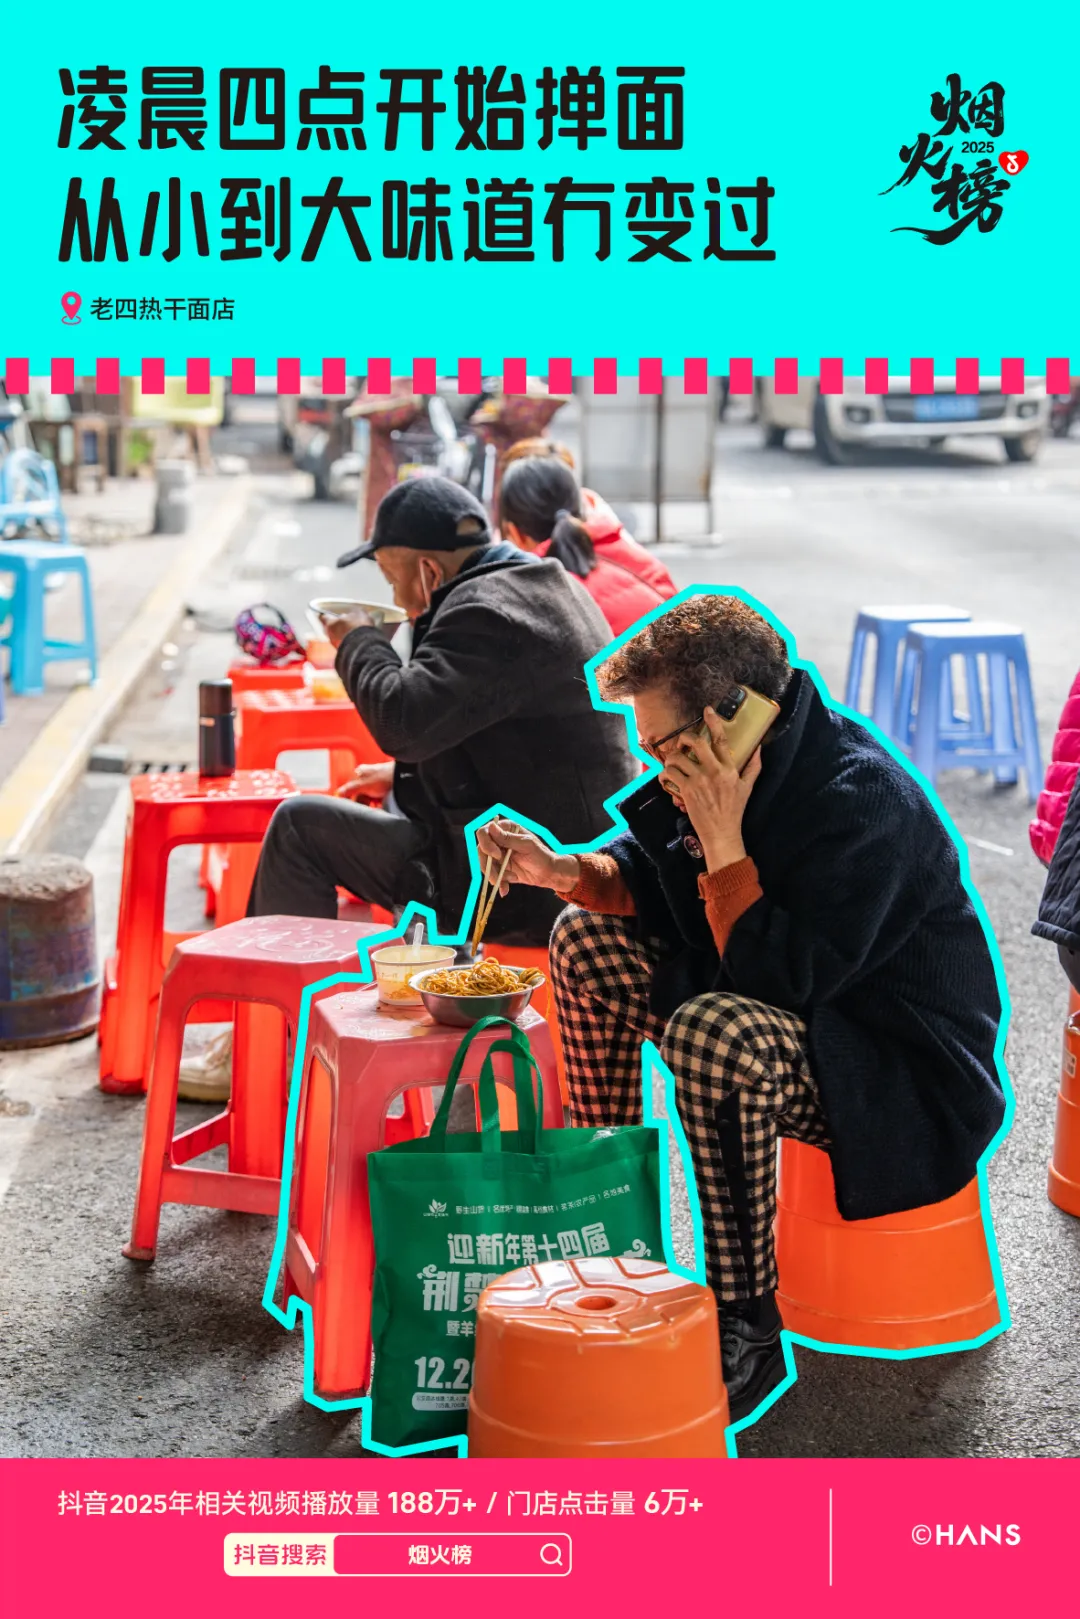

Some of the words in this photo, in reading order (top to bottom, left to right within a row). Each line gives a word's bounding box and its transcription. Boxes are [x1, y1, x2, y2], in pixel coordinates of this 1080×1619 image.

[447, 1222, 611, 1266] 迎新年第十四届
[446, 1320, 476, 1338] 暨羊
[414, 1356, 475, 1390] 12.2
